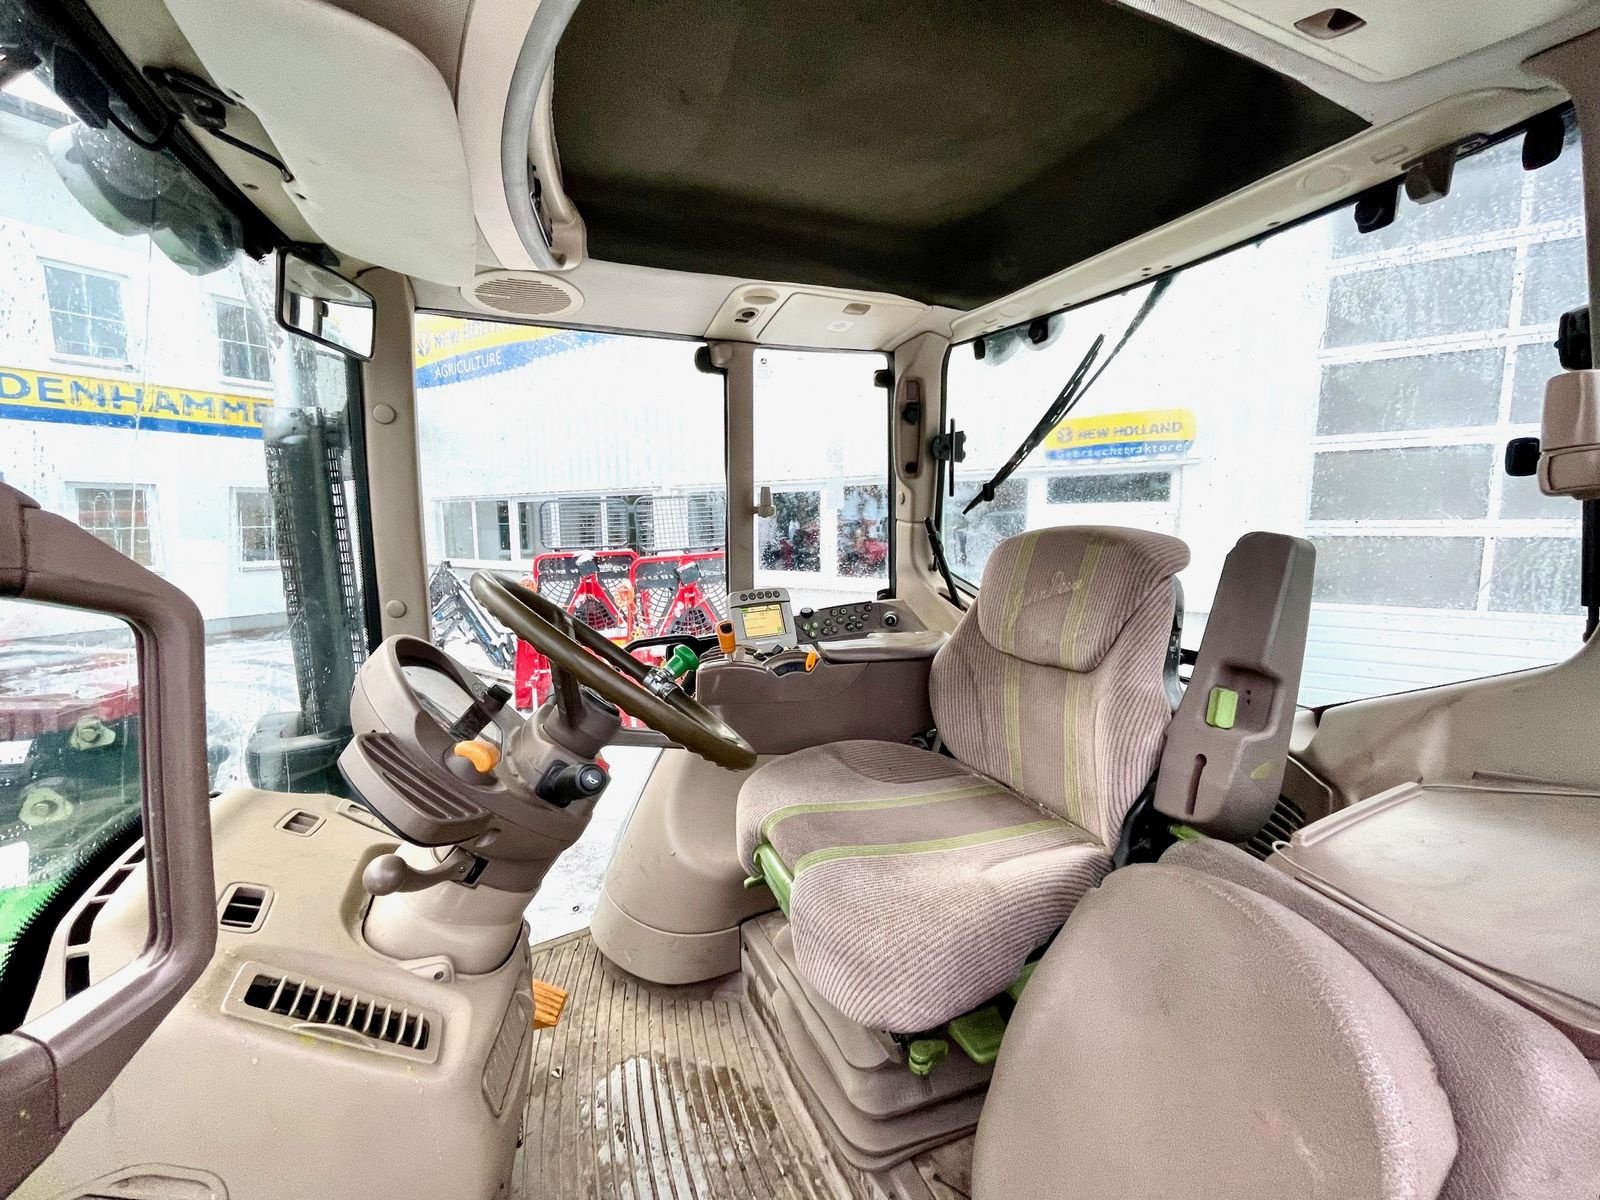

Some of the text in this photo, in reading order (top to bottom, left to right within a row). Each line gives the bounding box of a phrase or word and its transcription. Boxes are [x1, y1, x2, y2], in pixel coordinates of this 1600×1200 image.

[434, 350, 503, 380] AGRICULTURE
[1077, 421, 1184, 440] NEW HOLLAND
